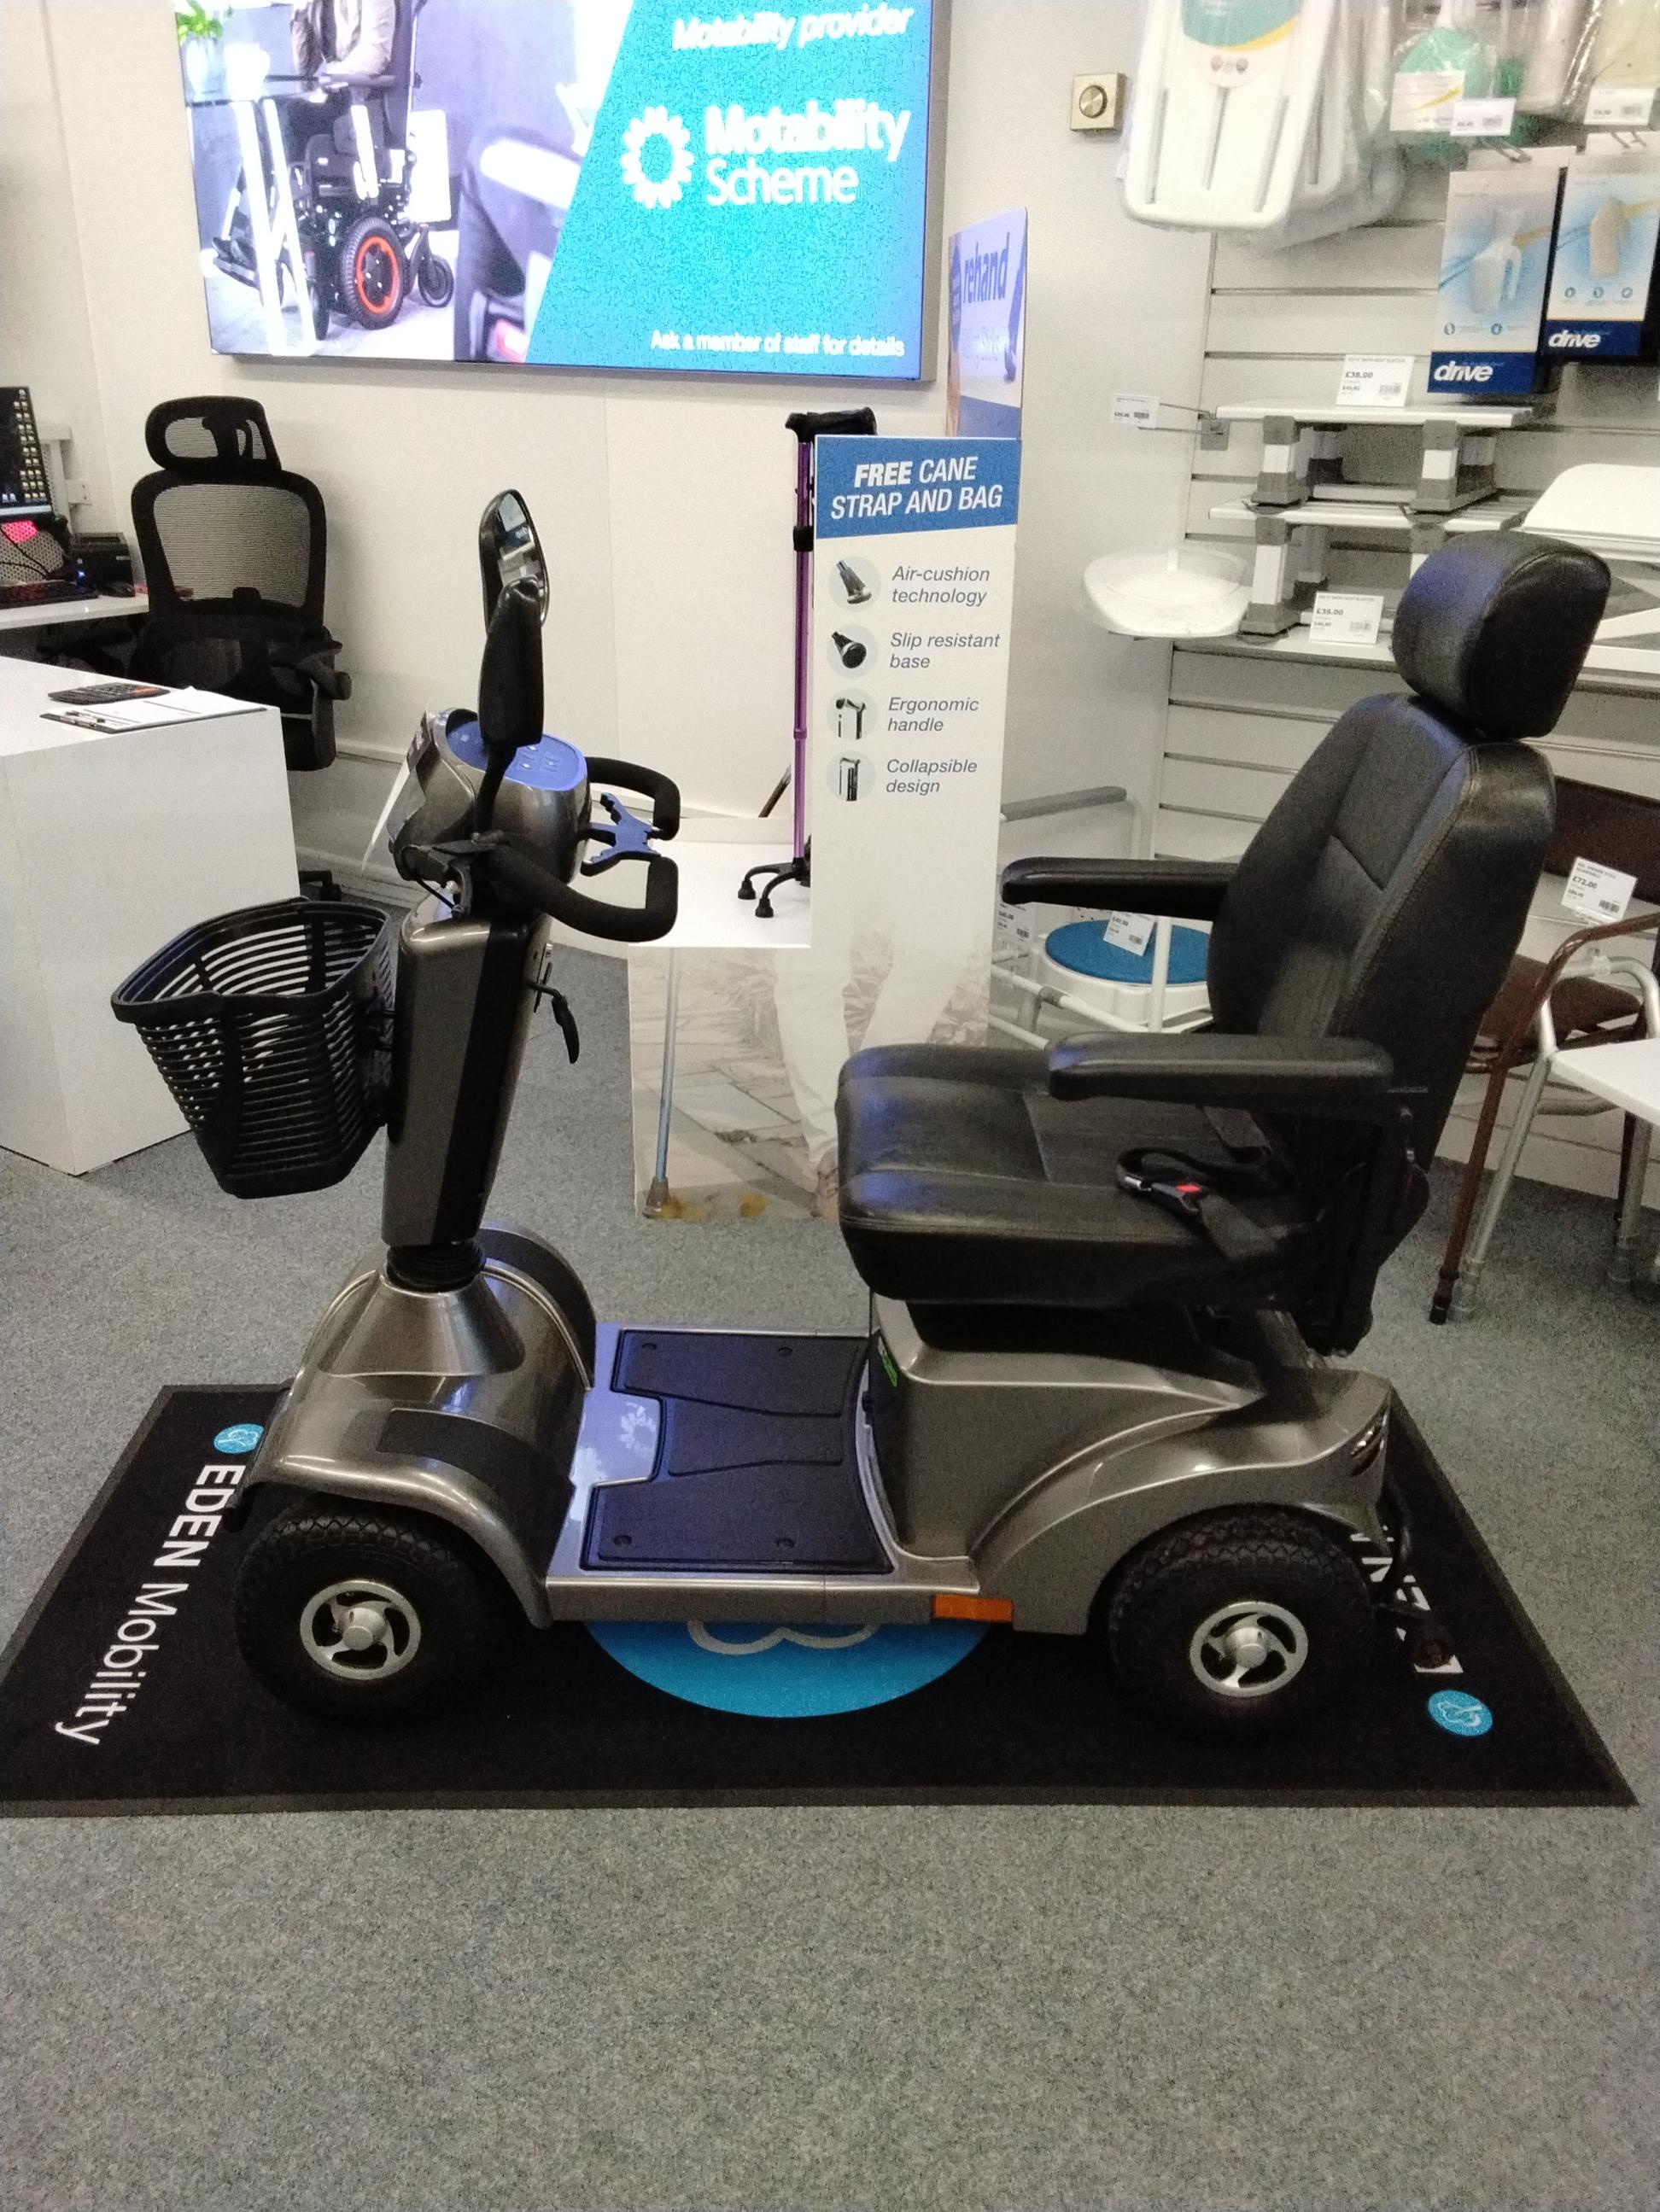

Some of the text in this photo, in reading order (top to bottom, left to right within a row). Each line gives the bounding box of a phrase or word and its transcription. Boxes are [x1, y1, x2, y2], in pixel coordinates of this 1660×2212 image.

[672, 2, 914, 50] Motability provider
[705, 98, 911, 162] Motability
[706, 156, 859, 206] Scheme
[963, 231, 1010, 304] rehand
[651, 330, 905, 357] Ask a member of staff for details
[1547, 330, 1601, 348] drive
[1434, 361, 1493, 382] drive
[854, 456, 979, 488] FREE CANE
[830, 484, 1003, 520] STRAP AND BAG
[891, 565, 991, 582] Air-cushion
[891, 587, 988, 608] technology
[891, 632, 1001, 651] Slip resistant
[889, 653, 931, 669] base
[888, 697, 979, 715] Ergonomic
[887, 717, 944, 732] handle
[886, 758, 978, 776] Collapsible
[886, 779, 941, 797] design
[55, 1464, 247, 1745] EDEN Mobility
